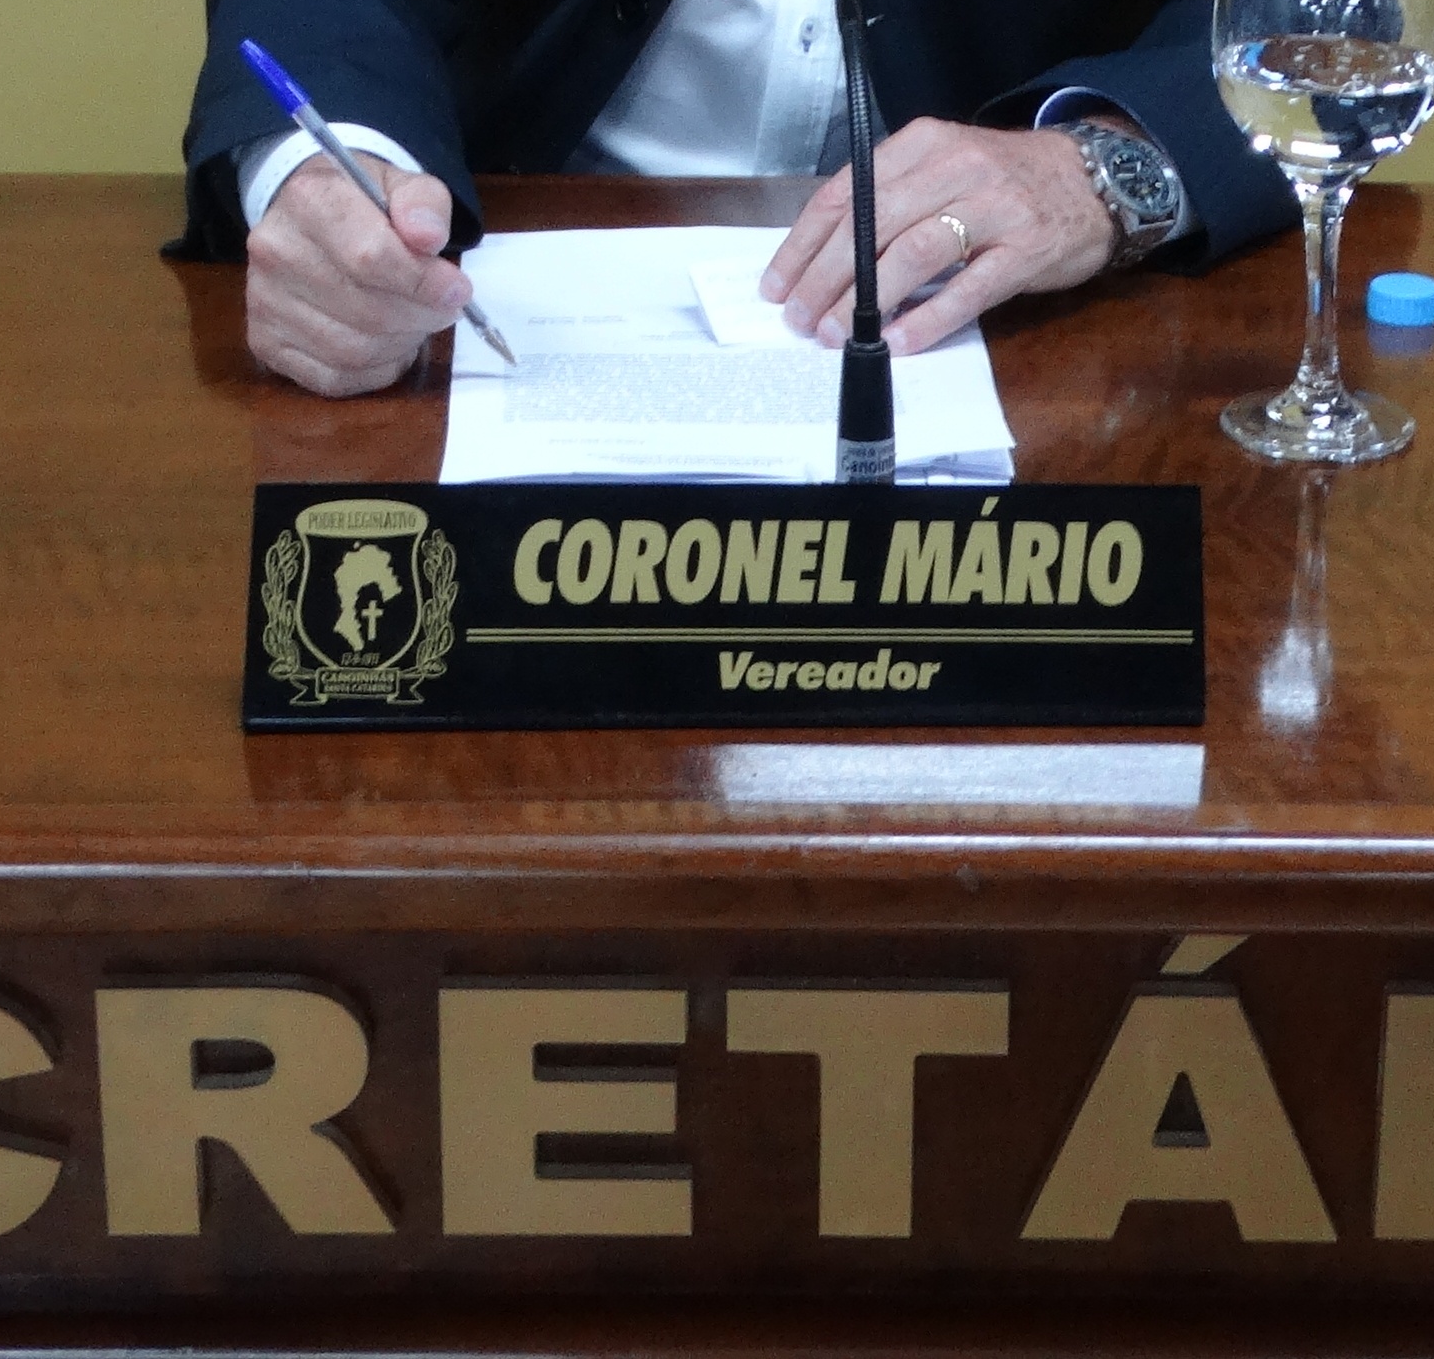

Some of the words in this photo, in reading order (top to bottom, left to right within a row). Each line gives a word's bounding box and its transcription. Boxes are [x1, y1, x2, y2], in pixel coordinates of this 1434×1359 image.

[513, 518, 857, 605] CORONEL
[879, 496, 1144, 607] MÁRIO
[718, 648, 942, 691] Vereador
